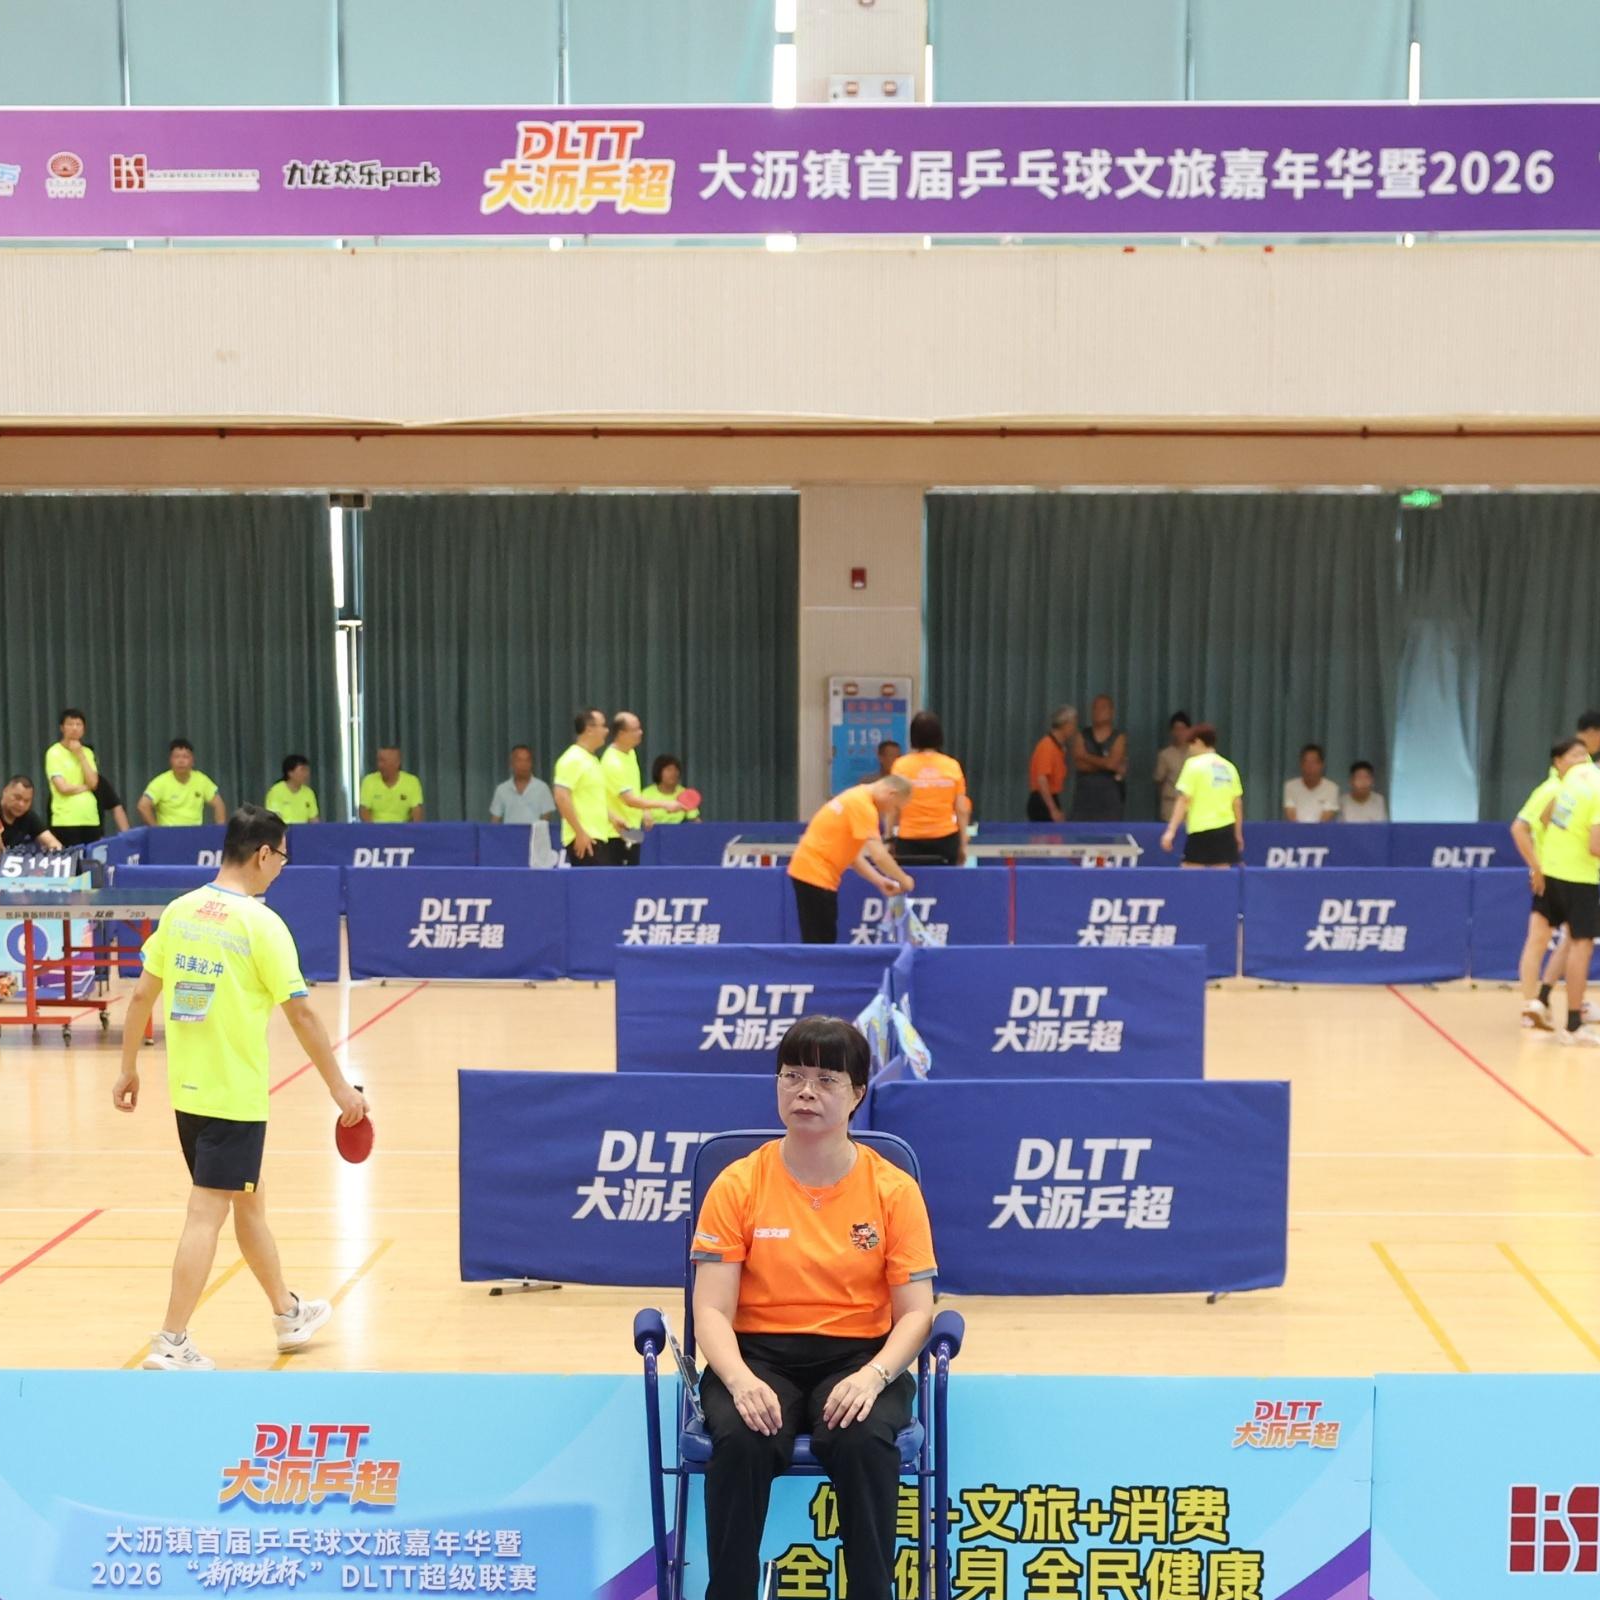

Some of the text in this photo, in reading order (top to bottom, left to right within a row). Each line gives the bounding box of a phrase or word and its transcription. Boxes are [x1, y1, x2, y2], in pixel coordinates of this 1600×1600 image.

[522, 126, 638, 160] DLTT
[483, 163, 673, 212] 大沥乒超
[2, 856, 23, 877] 5
[354, 848, 414, 867] DLTT
[1267, 848, 1329, 867] DLTT
[1432, 848, 1495, 867] DLTT
[420, 898, 493, 923] DLTT
[633, 898, 709, 923] DLTT
[1088, 898, 1165, 924] DLTT
[1317, 899, 1396, 925] DLTT
[409, 923, 505, 950] 大沥乒超
[622, 923, 720, 945] 大沥乒超
[1077, 925, 1177, 947] 大沥乒超
[1305, 926, 1408, 952] 大沥乒超
[717, 984, 814, 1016] DLTT
[1010, 986, 1108, 1018] DLTT
[699, 1018, 793, 1051] 大沥乒
[991, 1021, 1123, 1053] 大沥乒超
[1015, 1137, 1152, 1182] DLTT
[572, 1178, 692, 1223] 大沥乒
[989, 1184, 1174, 1230] 大沥乒超
[1255, 1401, 1323, 1421] DLTT
[254, 1423, 370, 1459] DLTT
[1234, 1421, 1341, 1449] 大沥乒超
[218, 1459, 401, 1506] 大沥乒超
[106, 1525, 522, 1559] 大沥镇首届乒乓球文旅嘉年华暨
[91, 1560, 163, 1587] 2026
[341, 1562, 537, 1592] DLTT超级联赛
